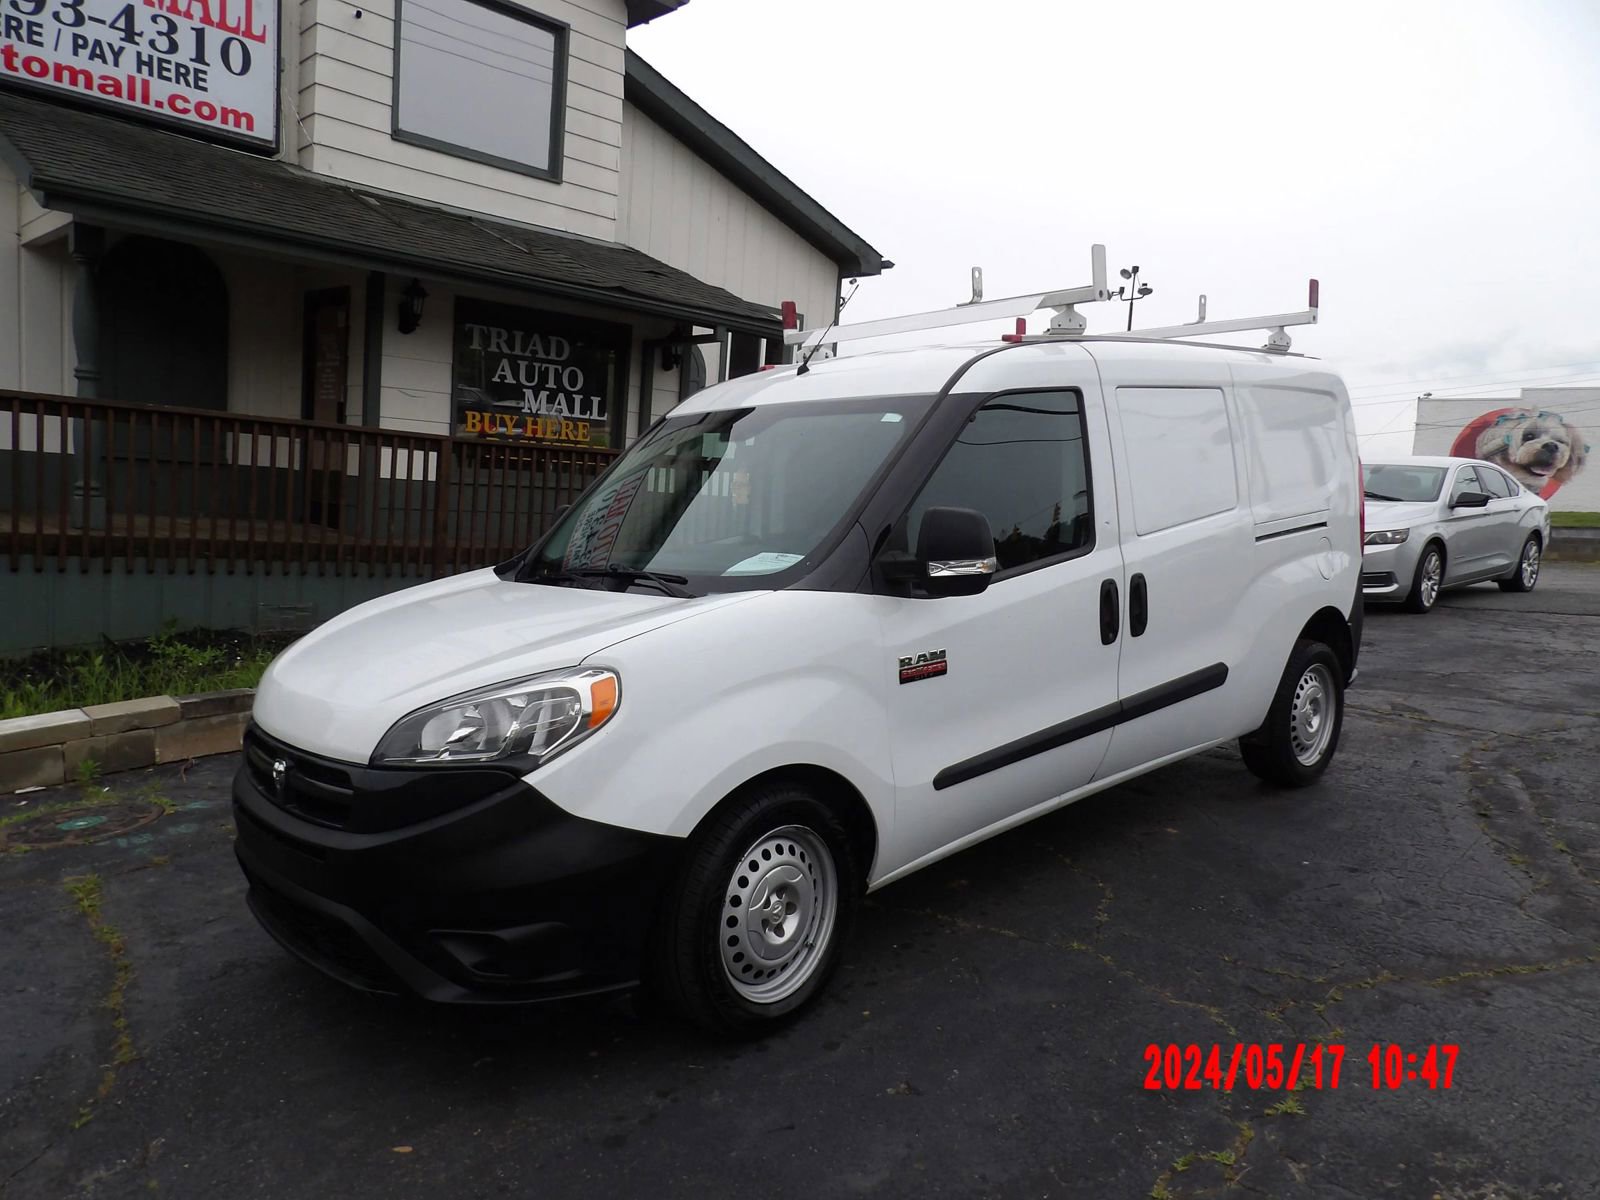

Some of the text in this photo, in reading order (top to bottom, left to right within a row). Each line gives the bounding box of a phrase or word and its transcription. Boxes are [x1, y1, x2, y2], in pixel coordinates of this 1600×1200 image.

[142, 0, 266, 45] ALL
[0, 12, 209, 93] RE / PAY HERE
[0, 44, 255, 132] tomall.com
[465, 323, 571, 361] TRIAD
[491, 358, 584, 392] AUTO
[521, 388, 608, 421] MALL
[465, 410, 591, 442] BUY HERE
[898, 648, 947, 668] RAM
